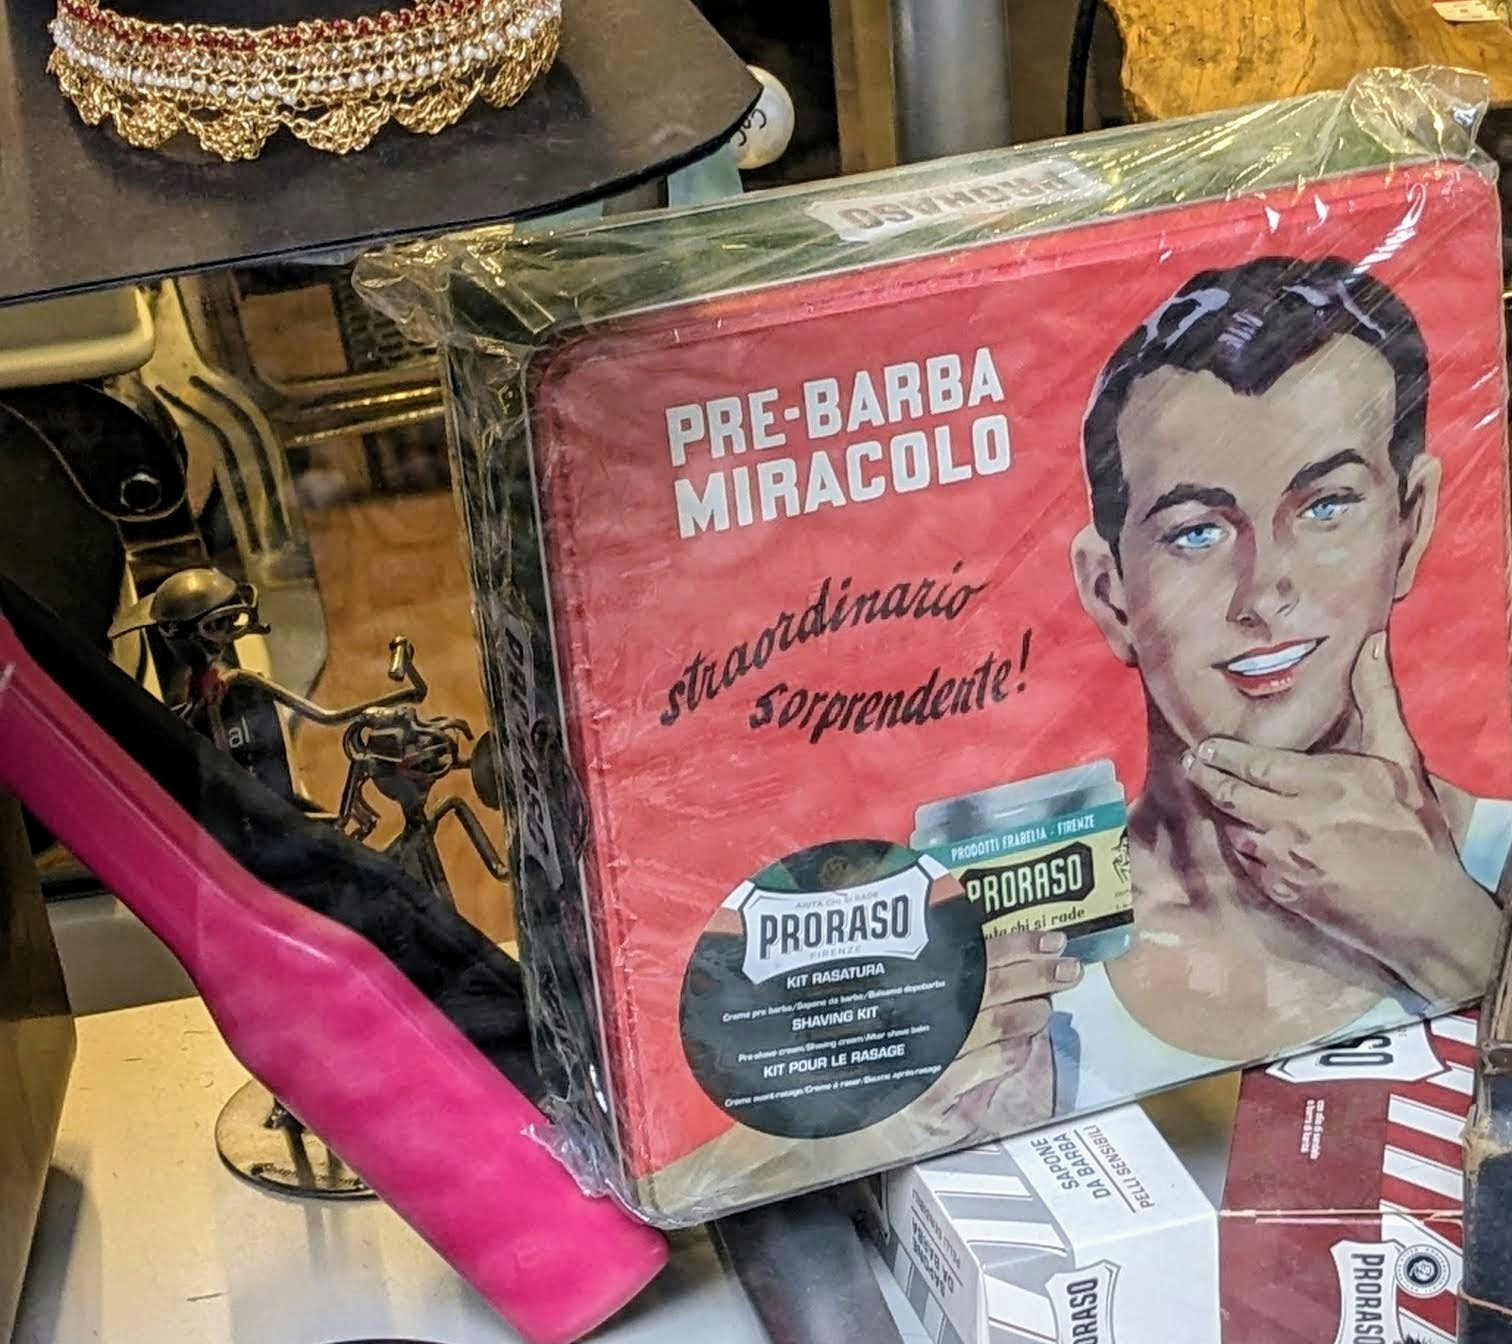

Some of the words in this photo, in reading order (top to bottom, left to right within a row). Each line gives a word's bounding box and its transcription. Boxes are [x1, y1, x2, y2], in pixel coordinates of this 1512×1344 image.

[665, 347, 1004, 467] PRE-BARBA
[674, 414, 1011, 539] MIRACOLO
[660, 560, 991, 728] straordinario
[951, 840, 1000, 861] PRODOTTI
[1057, 814, 1095, 835] FIRENZE
[966, 854, 1083, 913] PRORASO
[759, 894, 912, 961] PRORASO
[787, 974, 808, 990] KIT
[812, 962, 885, 986] RASATURA
[792, 1009, 853, 1031] SHAVING
[857, 1005, 879, 1020] KIT
[763, 1063, 785, 1079] KIT
[789, 1057, 827, 1073] POUR
[851, 1043, 905, 1063] RASAGE
[1031, 1137, 1080, 1191] SAPONE
[1053, 1132, 1095, 1179] BARBA
[1084, 1124, 1132, 1177] SENSIBILI
[1087, 1180, 1111, 1200] DA
[1123, 1176, 1155, 1209] PELLI
